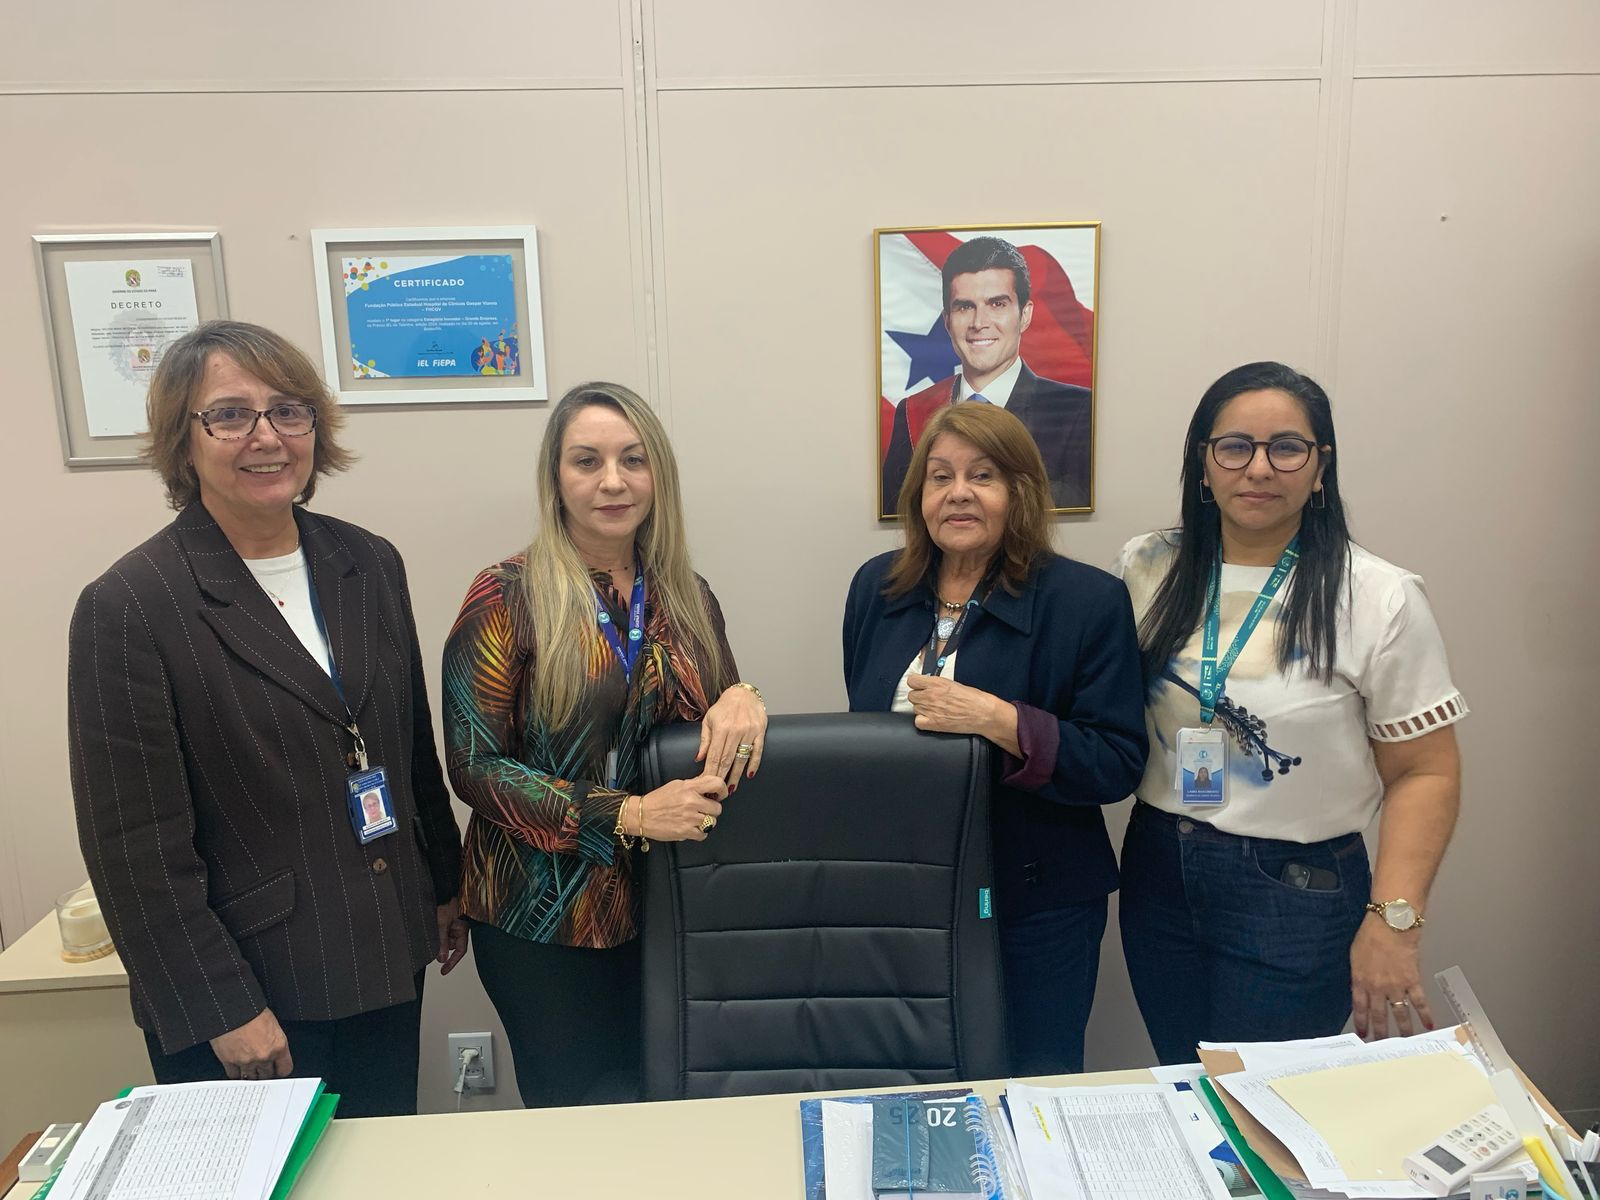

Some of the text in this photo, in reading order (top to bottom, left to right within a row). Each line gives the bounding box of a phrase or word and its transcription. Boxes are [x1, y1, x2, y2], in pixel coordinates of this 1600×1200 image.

[394, 279, 465, 287] CERTIFICADO
[110, 301, 162, 309] DECRETO
[926, 1107, 957, 1127] 20
